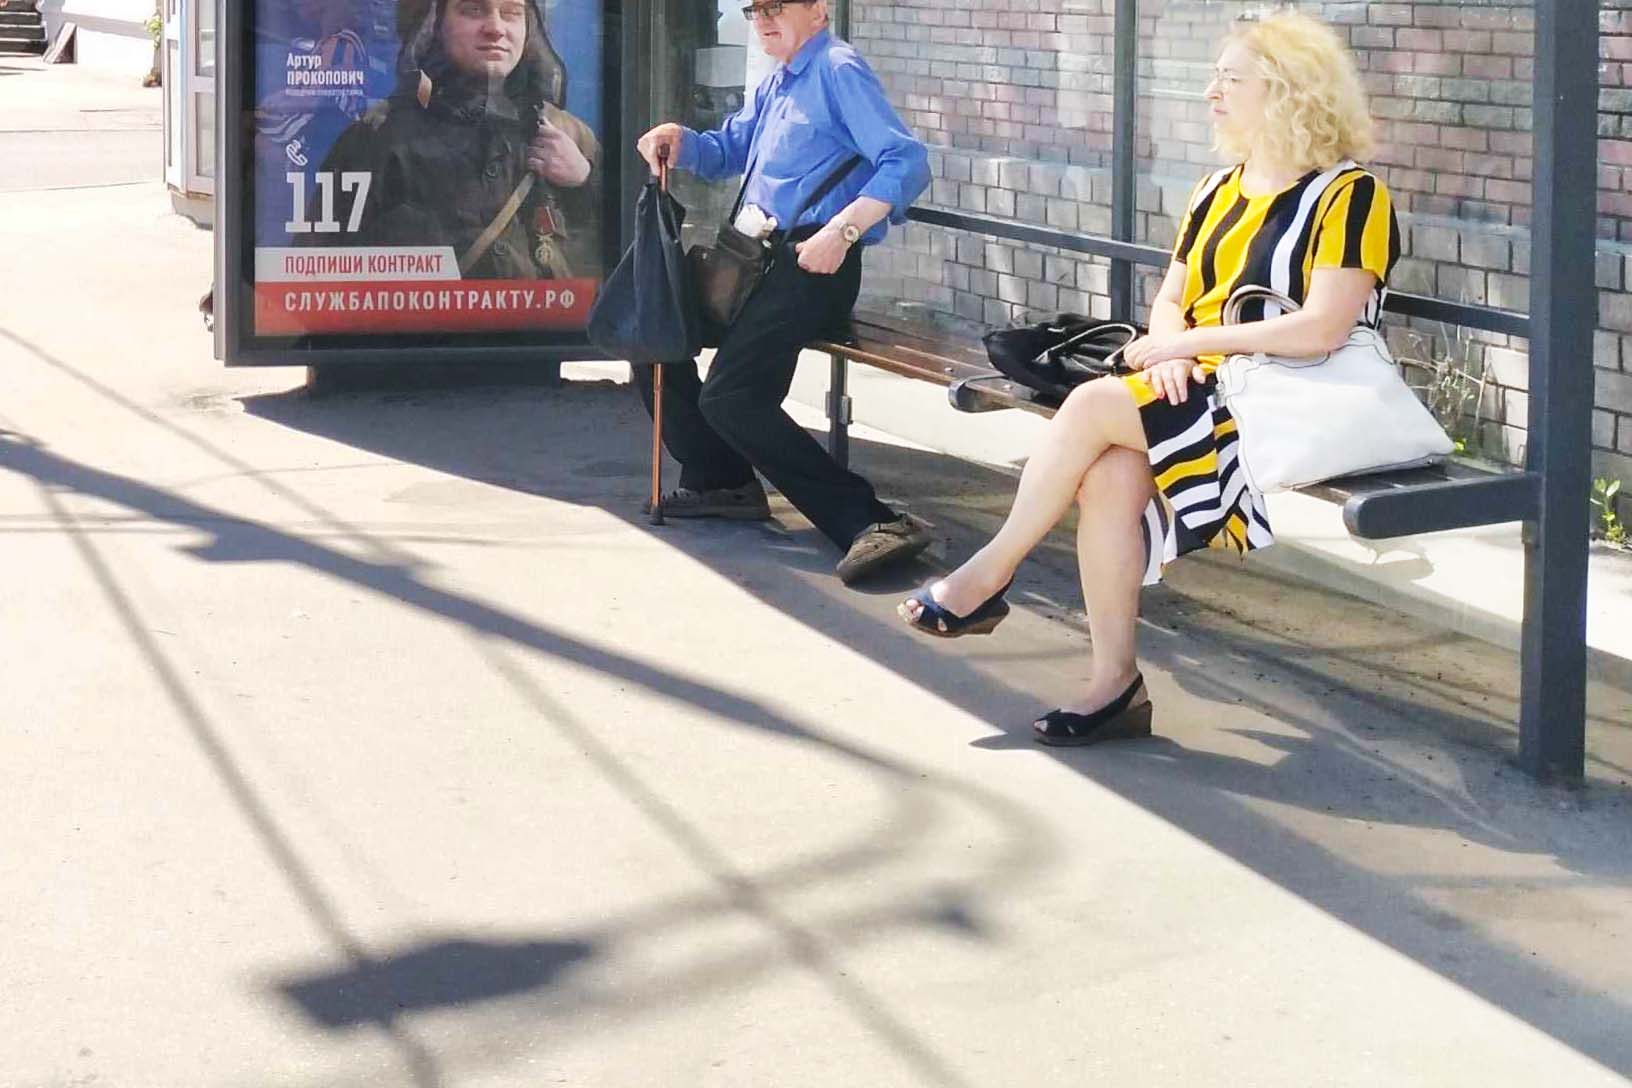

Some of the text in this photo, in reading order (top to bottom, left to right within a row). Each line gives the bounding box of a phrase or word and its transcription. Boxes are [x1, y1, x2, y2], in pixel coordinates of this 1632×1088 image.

[286, 52, 322, 71] Артур
[287, 69, 364, 86] ПРОКОПОВИЧ
[285, 171, 372, 233] 117
[285, 253, 443, 276] ПОДПИШИ КОНТРАКТ
[285, 289, 575, 312] СЛУЖБАПОКОНТРАКТУ.РФ
